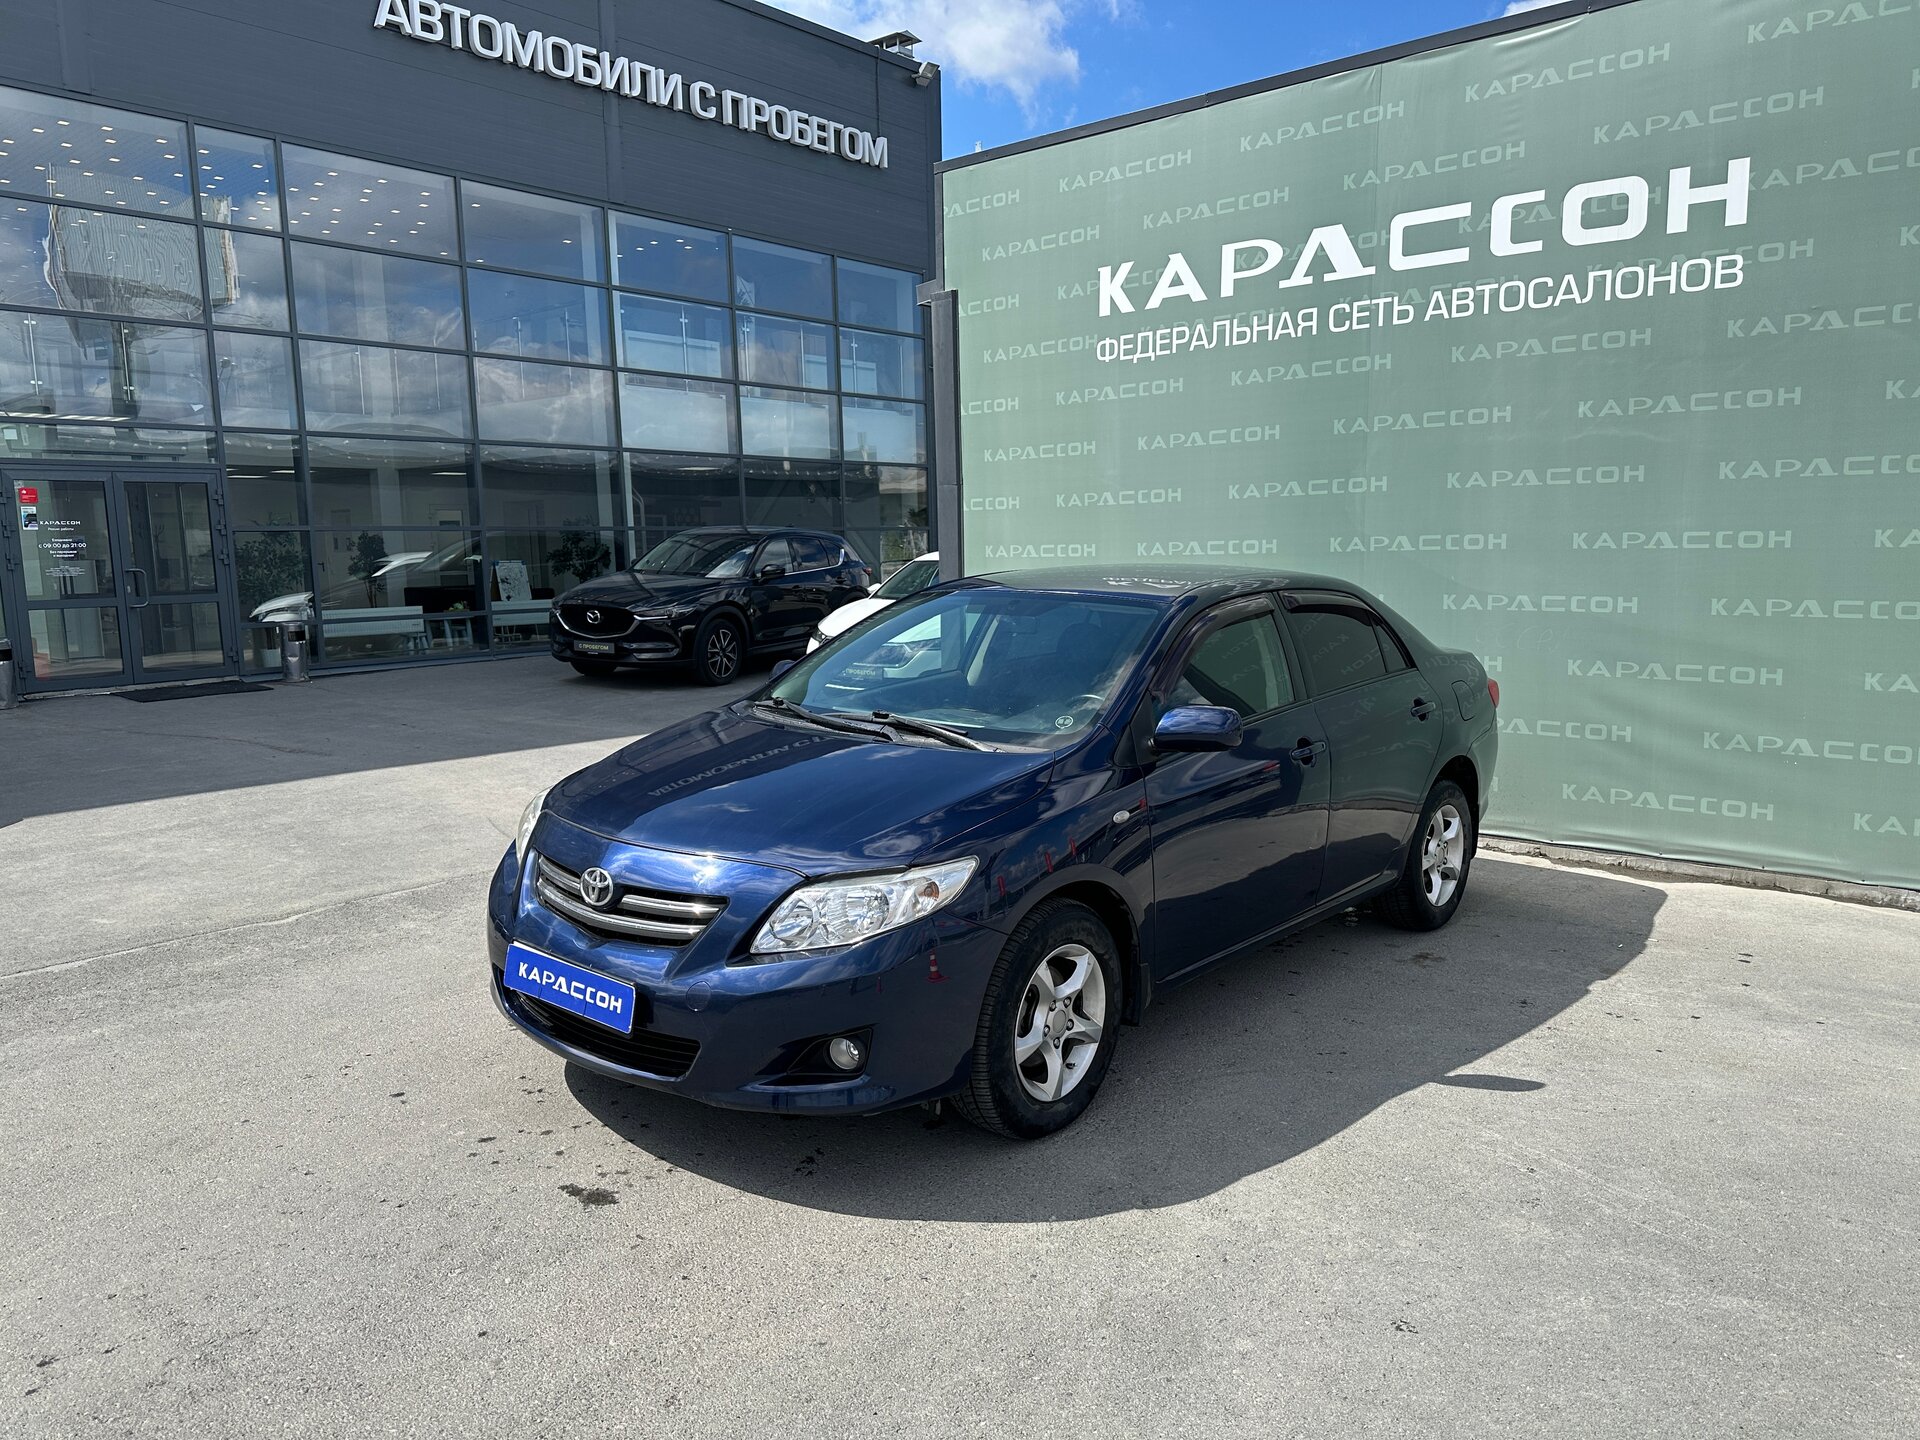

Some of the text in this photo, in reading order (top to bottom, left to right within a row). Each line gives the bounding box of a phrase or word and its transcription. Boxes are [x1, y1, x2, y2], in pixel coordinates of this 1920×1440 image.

[374, 0, 888, 169] АВТОМОБИЛИ С ПРОБЕГОМ
[1466, 42, 1671, 102] КАРАССОН
[1240, 101, 1405, 153] КАРАССОН
[1594, 86, 1824, 145] КАРАССОН
[1059, 149, 1192, 193] КАРАССОН
[1343, 141, 1526, 191] КАРАССОН
[1143, 187, 1290, 230] КАРАССОН
[982, 225, 1101, 262] КАРАССОН
[1097, 156, 1751, 318] КАРАССОН
[1096, 254, 1745, 364] ФЕДЕРАЛЬНАЯ СЕТЬ АВТОСАЛОНОВ
[1727, 303, 1920, 338] КАРАСС
[984, 334, 1098, 363] КАРАССОН
[1452, 327, 1652, 364] КАРАССОН
[1231, 353, 1393, 387] КАРАССОН
[1056, 377, 1184, 406] КАРАССОН
[1578, 386, 1802, 419] КАРАССОН
[1333, 405, 1512, 435] КАРАССОН
[984, 440, 1097, 462] КАРАССОН
[1137, 424, 1281, 451] КАРАССОН
[1228, 475, 1388, 500] КАРАССОН
[1446, 464, 1646, 489] КАРАССОН
[963, 496, 1020, 511] ССОН
[1056, 487, 1183, 508] КАРАССОН
[985, 543, 1097, 558] КАРАССОН
[1136, 538, 1278, 557] КАРАССОН
[1329, 533, 1508, 554] КАРАССОН
[1572, 530, 1792, 550] КАРАССОН
[1443, 594, 1639, 615] КАРАССОН
[1567, 659, 1784, 687] КАРАССОН
[1864, 672, 1920, 694] КА
[1703, 732, 1920, 765] КАРАССО
[1562, 783, 1775, 822] КАРАССОН
[517, 960, 623, 1014] КАРАССОН
